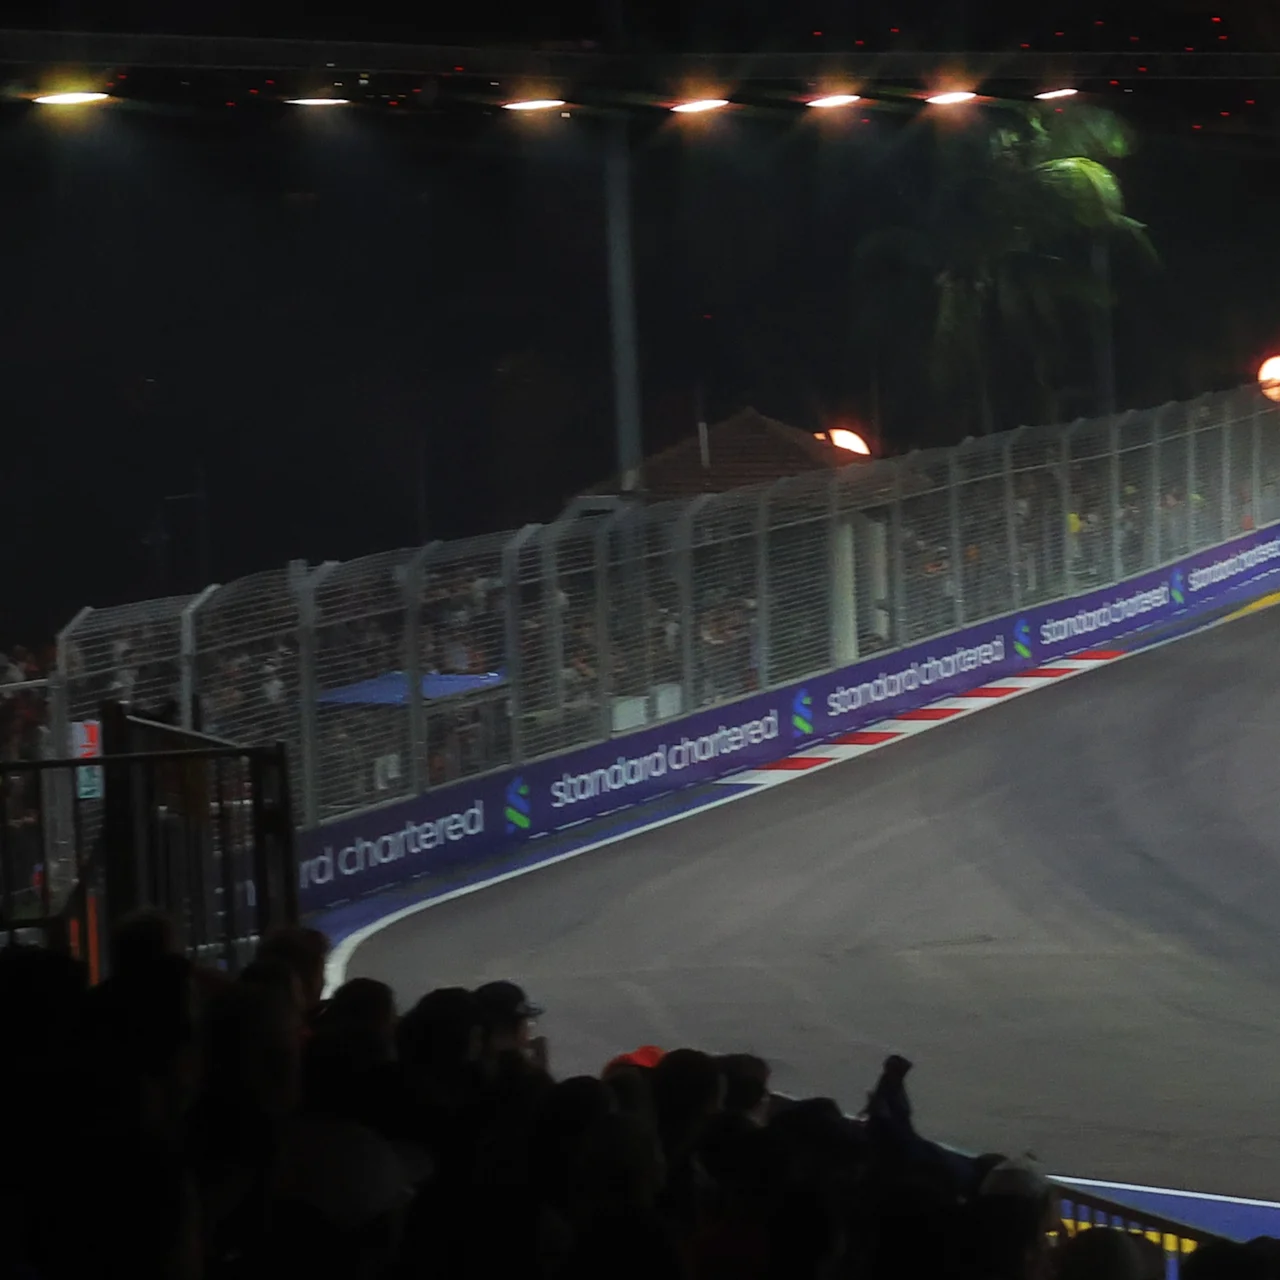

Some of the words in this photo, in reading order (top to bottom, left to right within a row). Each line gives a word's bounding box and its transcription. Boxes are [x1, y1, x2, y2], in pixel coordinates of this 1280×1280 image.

[828, 662, 919, 716] standard
[919, 635, 1005, 685] chartered
[551, 744, 667, 808] standard
[667, 709, 779, 770] chartered
[338, 799, 485, 876] chartered
